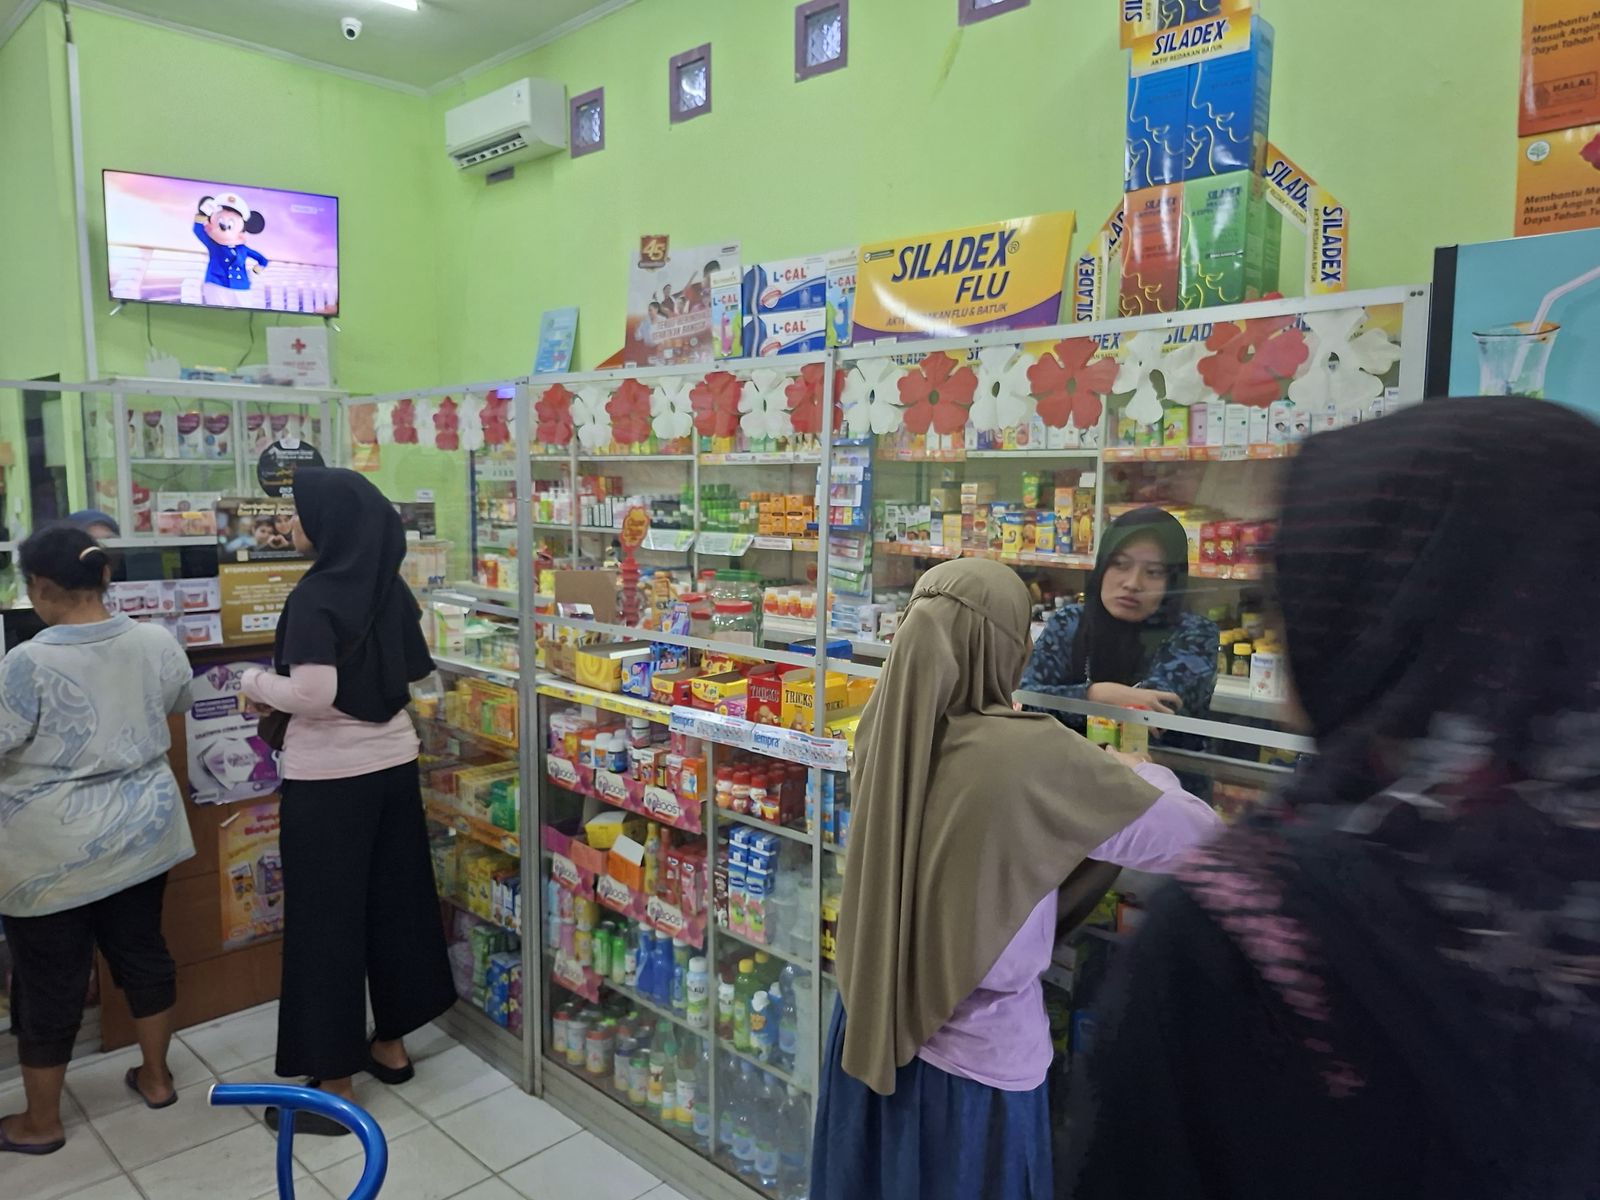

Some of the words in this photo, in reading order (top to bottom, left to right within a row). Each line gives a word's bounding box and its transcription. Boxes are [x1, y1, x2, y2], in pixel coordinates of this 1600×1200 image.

[1152, 19, 1226, 56] SILADEX
[1552, 78, 1592, 92] HALAL
[1320, 205, 1344, 282] SILADEX
[773, 267, 808, 283] L-CAL
[954, 271, 1010, 304] FLU
[1077, 256, 1095, 322] SILADEX
[773, 319, 807, 334] L-CAL
[785, 689, 813, 709] TRICKS
